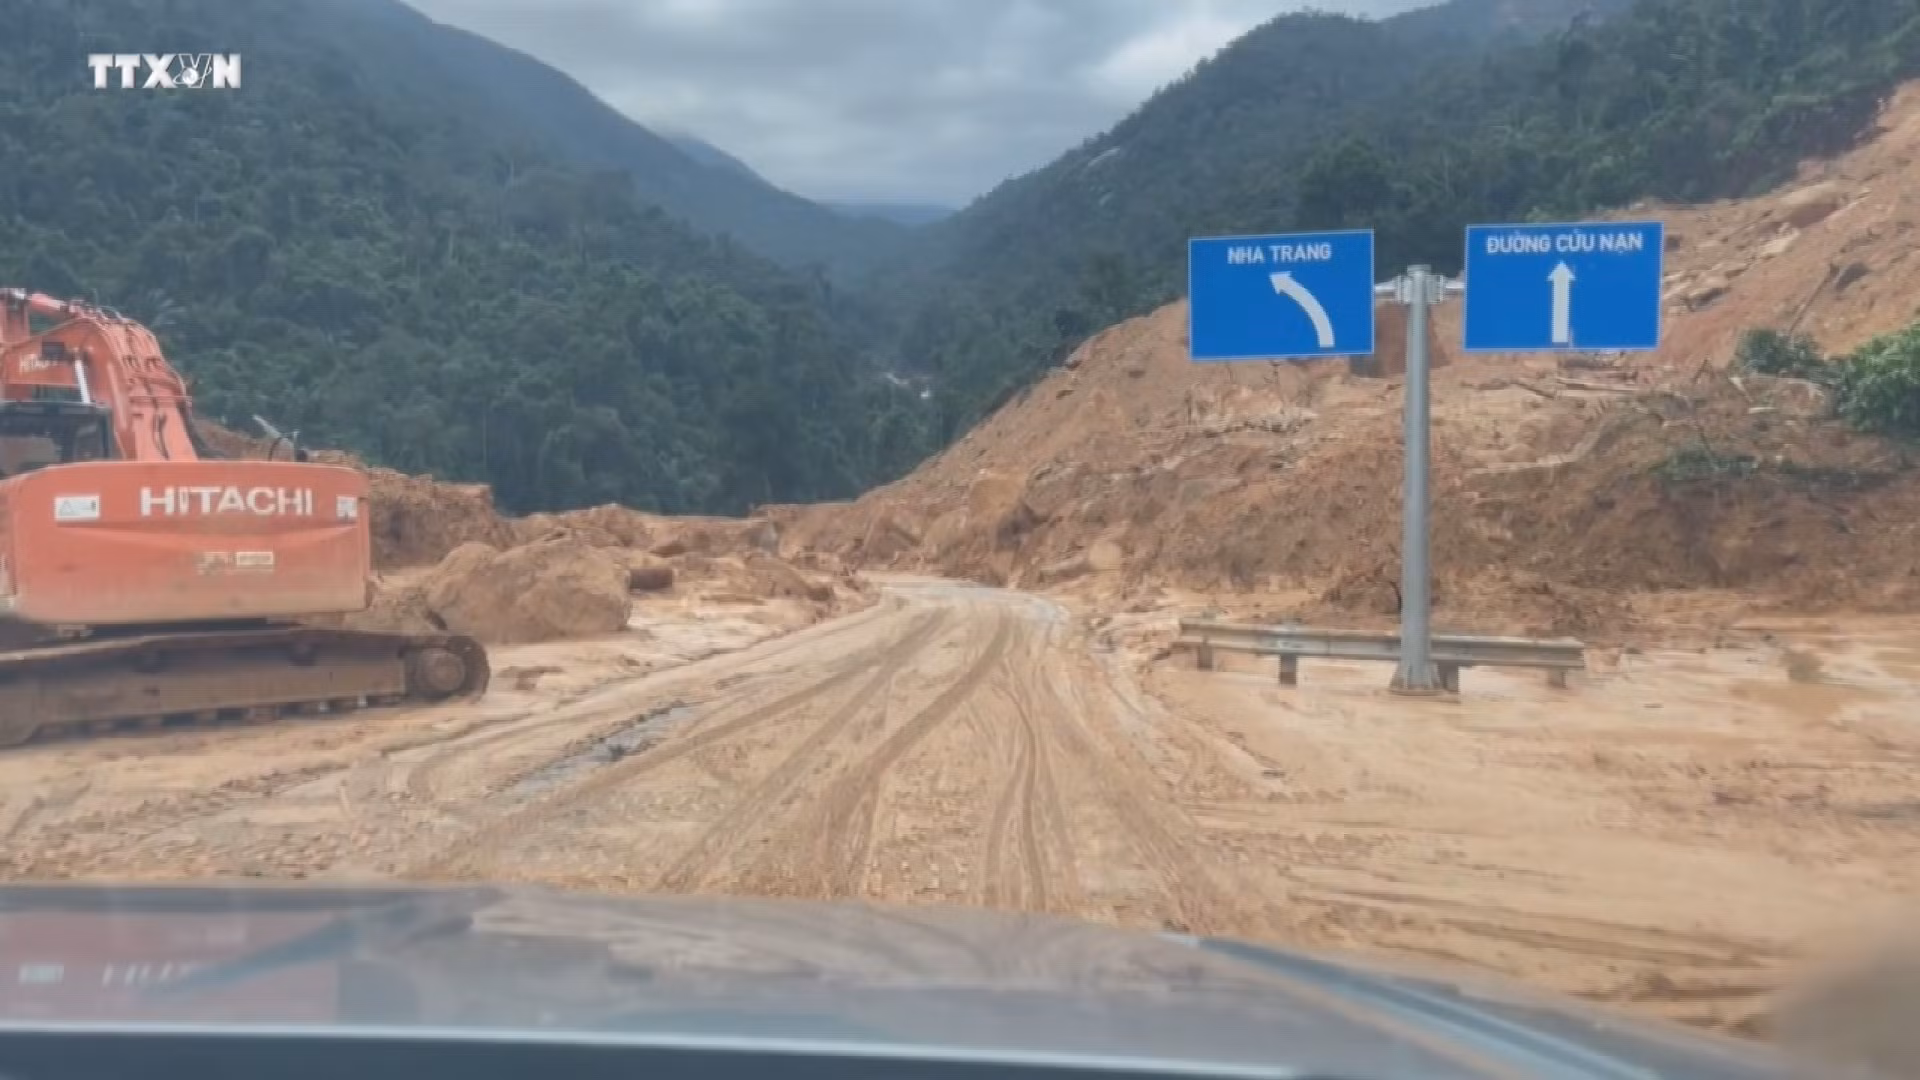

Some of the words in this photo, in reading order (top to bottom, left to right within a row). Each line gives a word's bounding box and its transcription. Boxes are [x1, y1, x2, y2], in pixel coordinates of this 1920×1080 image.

[1227, 246, 1265, 265] NHA
[1269, 242, 1332, 263] TRANG
[1485, 230, 1551, 254] ĐƯỜNG
[1598, 232, 1644, 255] NẠN
[140, 486, 313, 516] HITACHI
